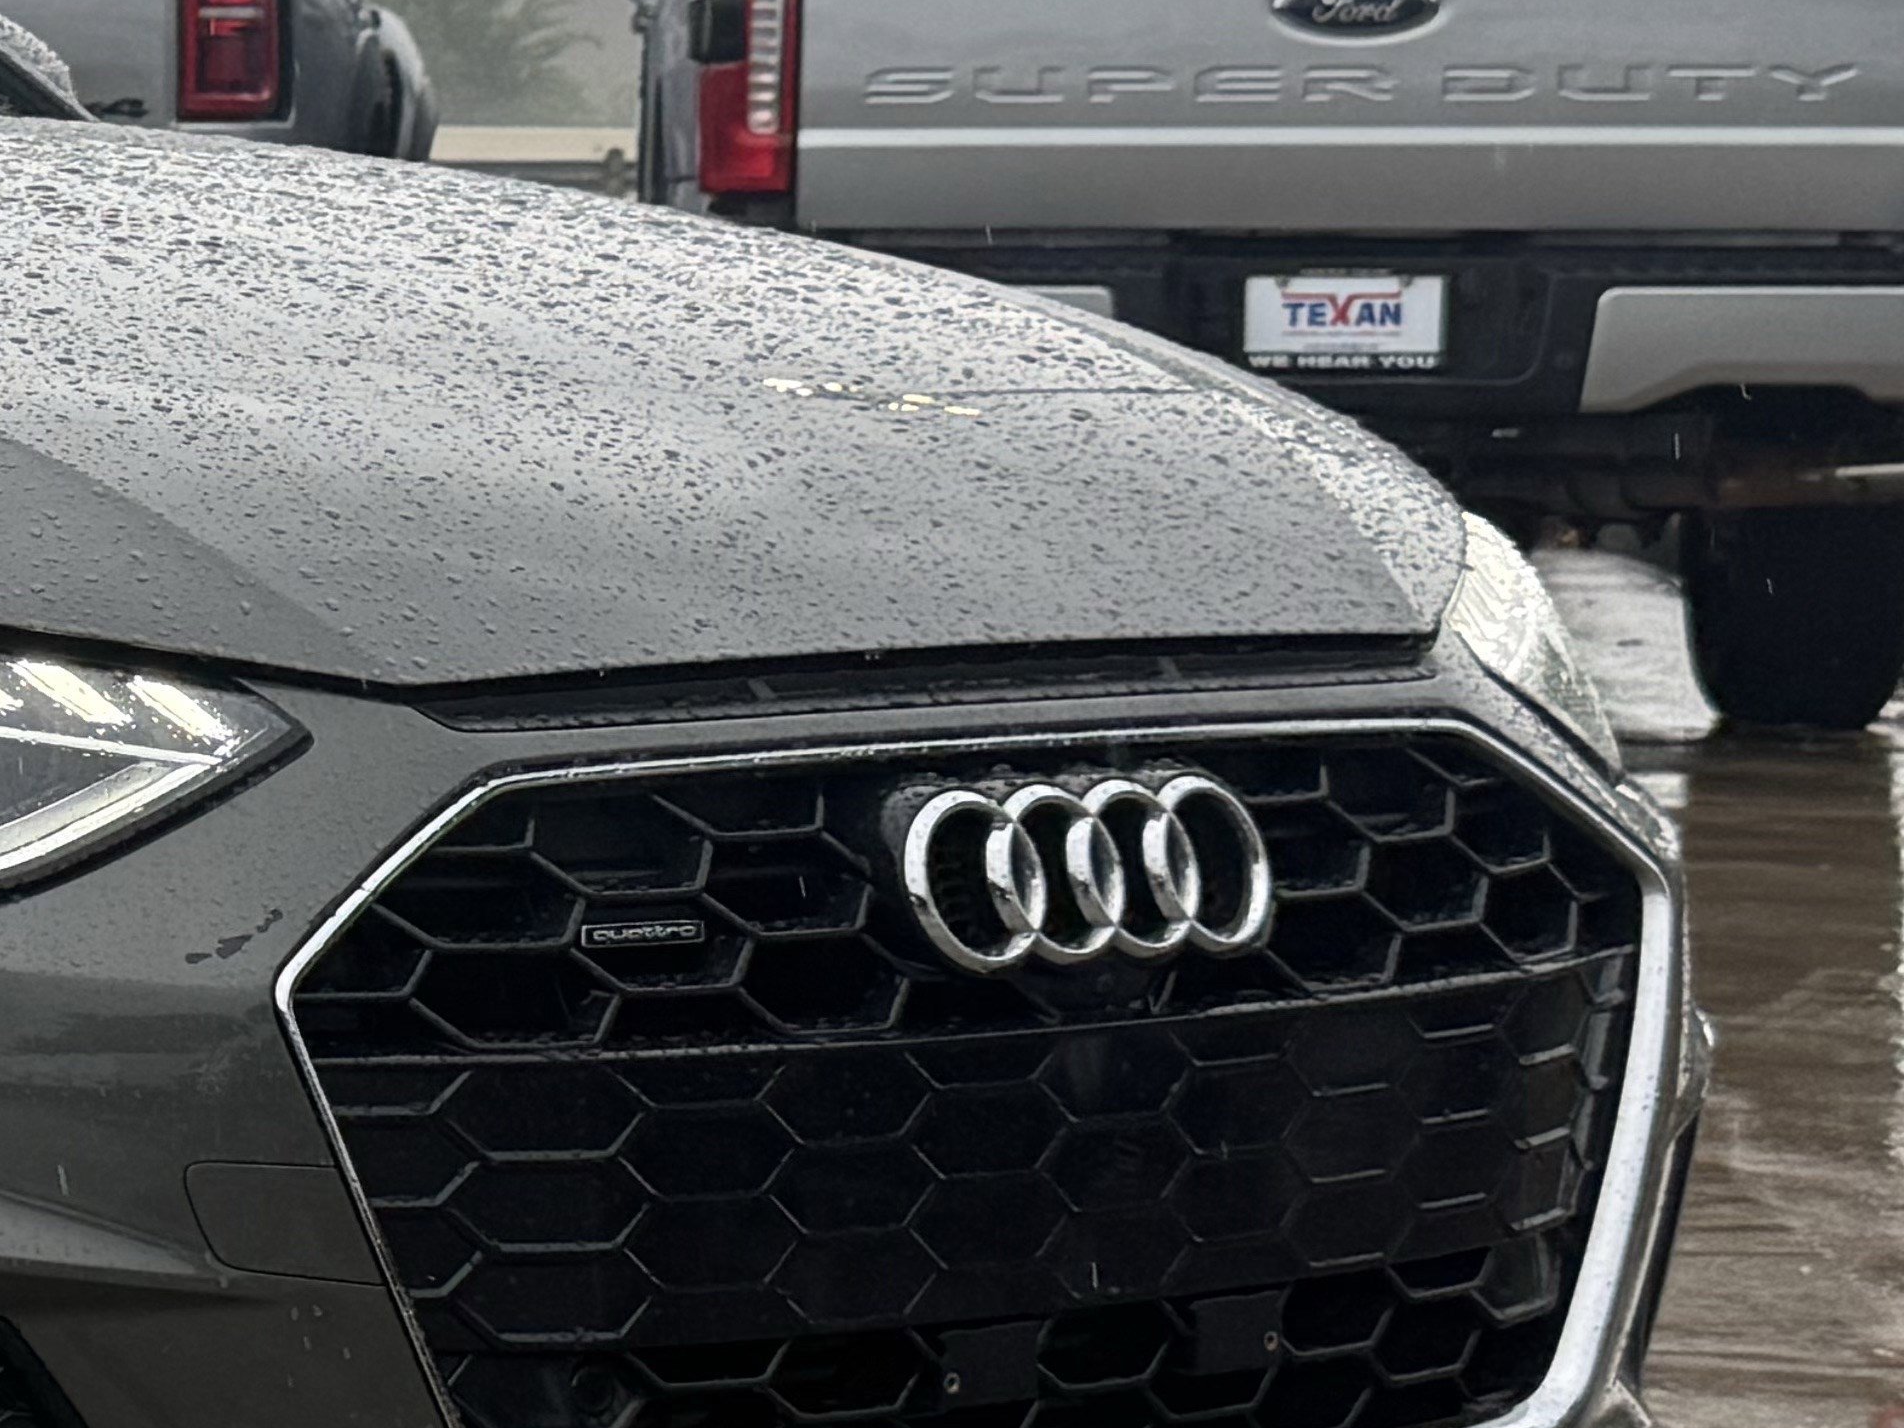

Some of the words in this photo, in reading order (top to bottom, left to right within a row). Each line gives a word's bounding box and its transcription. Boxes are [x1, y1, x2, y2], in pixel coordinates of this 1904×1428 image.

[864, 65, 1398, 103] SUPER
[1441, 63, 1859, 102] DUTY
[1281, 291, 1403, 327] TEXAN
[1379, 355, 1436, 368] YOU
[592, 924, 697, 943] quattro
